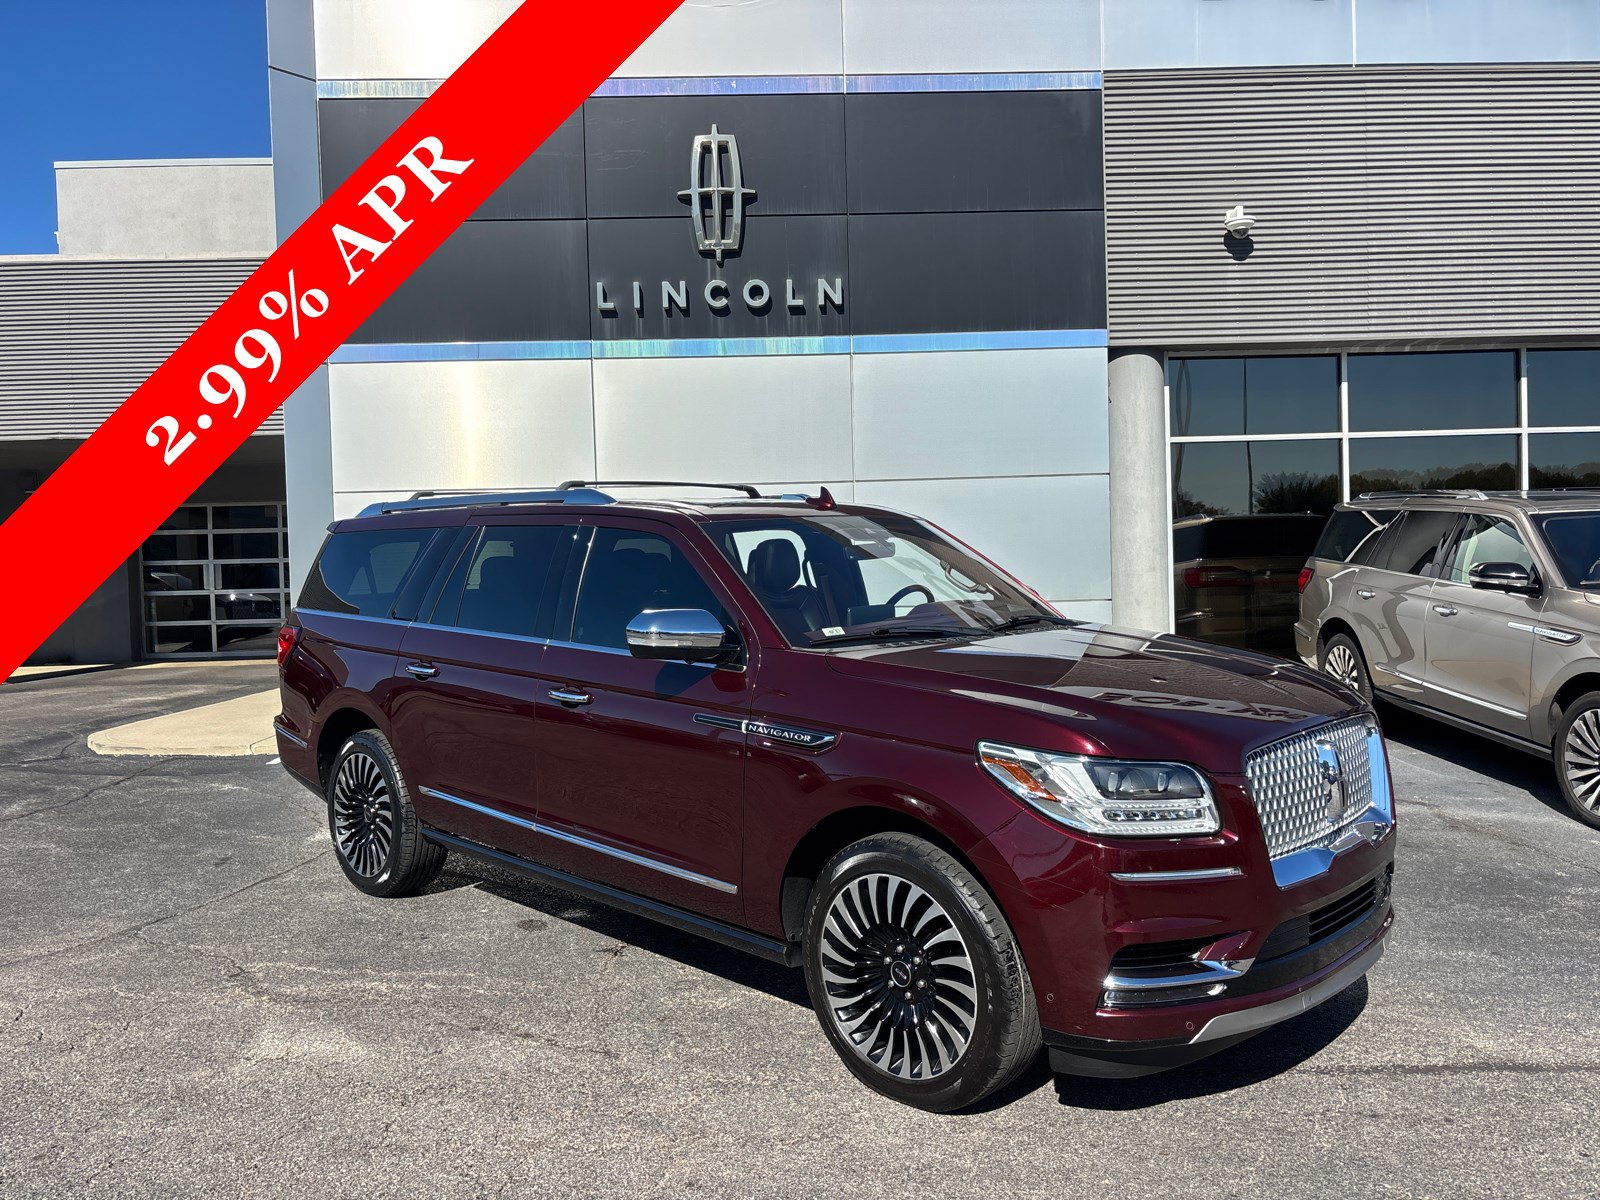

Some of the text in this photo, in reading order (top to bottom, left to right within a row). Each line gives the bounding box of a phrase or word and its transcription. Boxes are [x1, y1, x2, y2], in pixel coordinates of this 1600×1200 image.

[596, 278, 843, 311] LINCOLN
[1535, 628, 1567, 639] NAVIGATOR
[748, 724, 812, 742] NAVIGATOR
